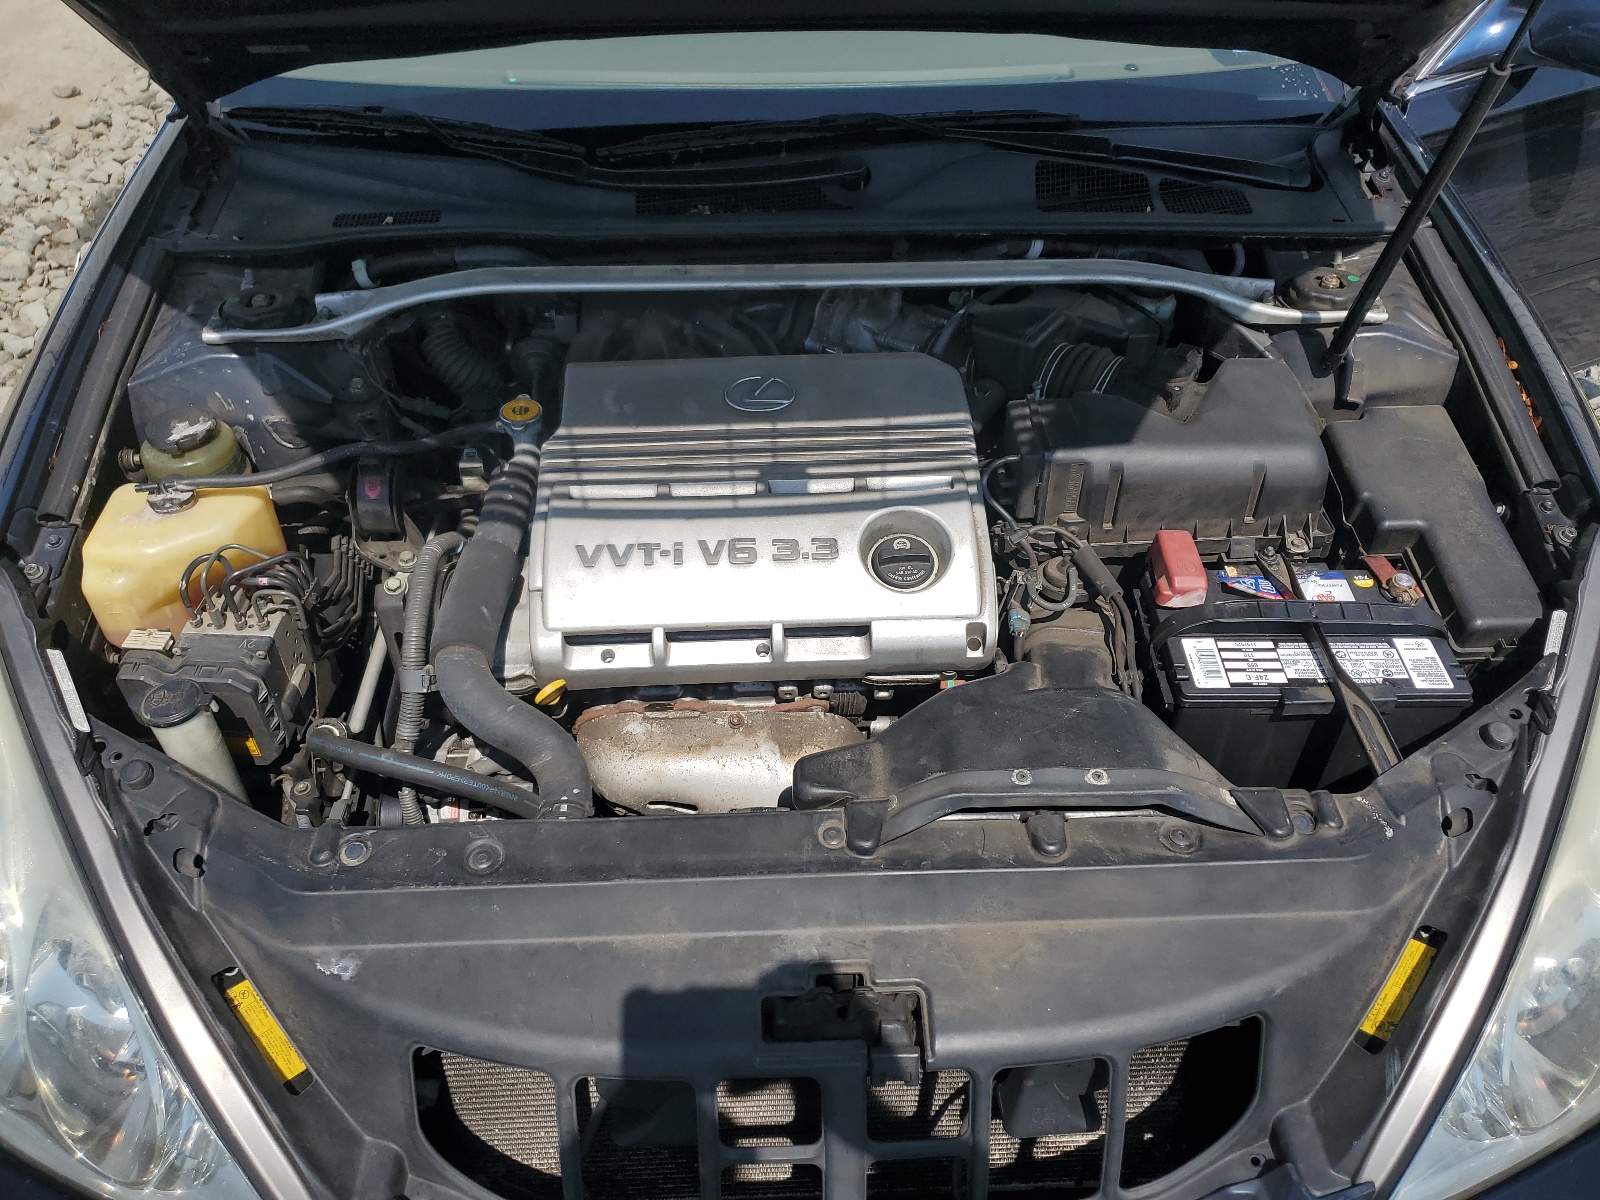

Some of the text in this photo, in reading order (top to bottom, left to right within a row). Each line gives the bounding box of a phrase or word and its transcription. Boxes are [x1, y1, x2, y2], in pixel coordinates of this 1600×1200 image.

[575, 537, 840, 568] VVT-i V6 3.3
